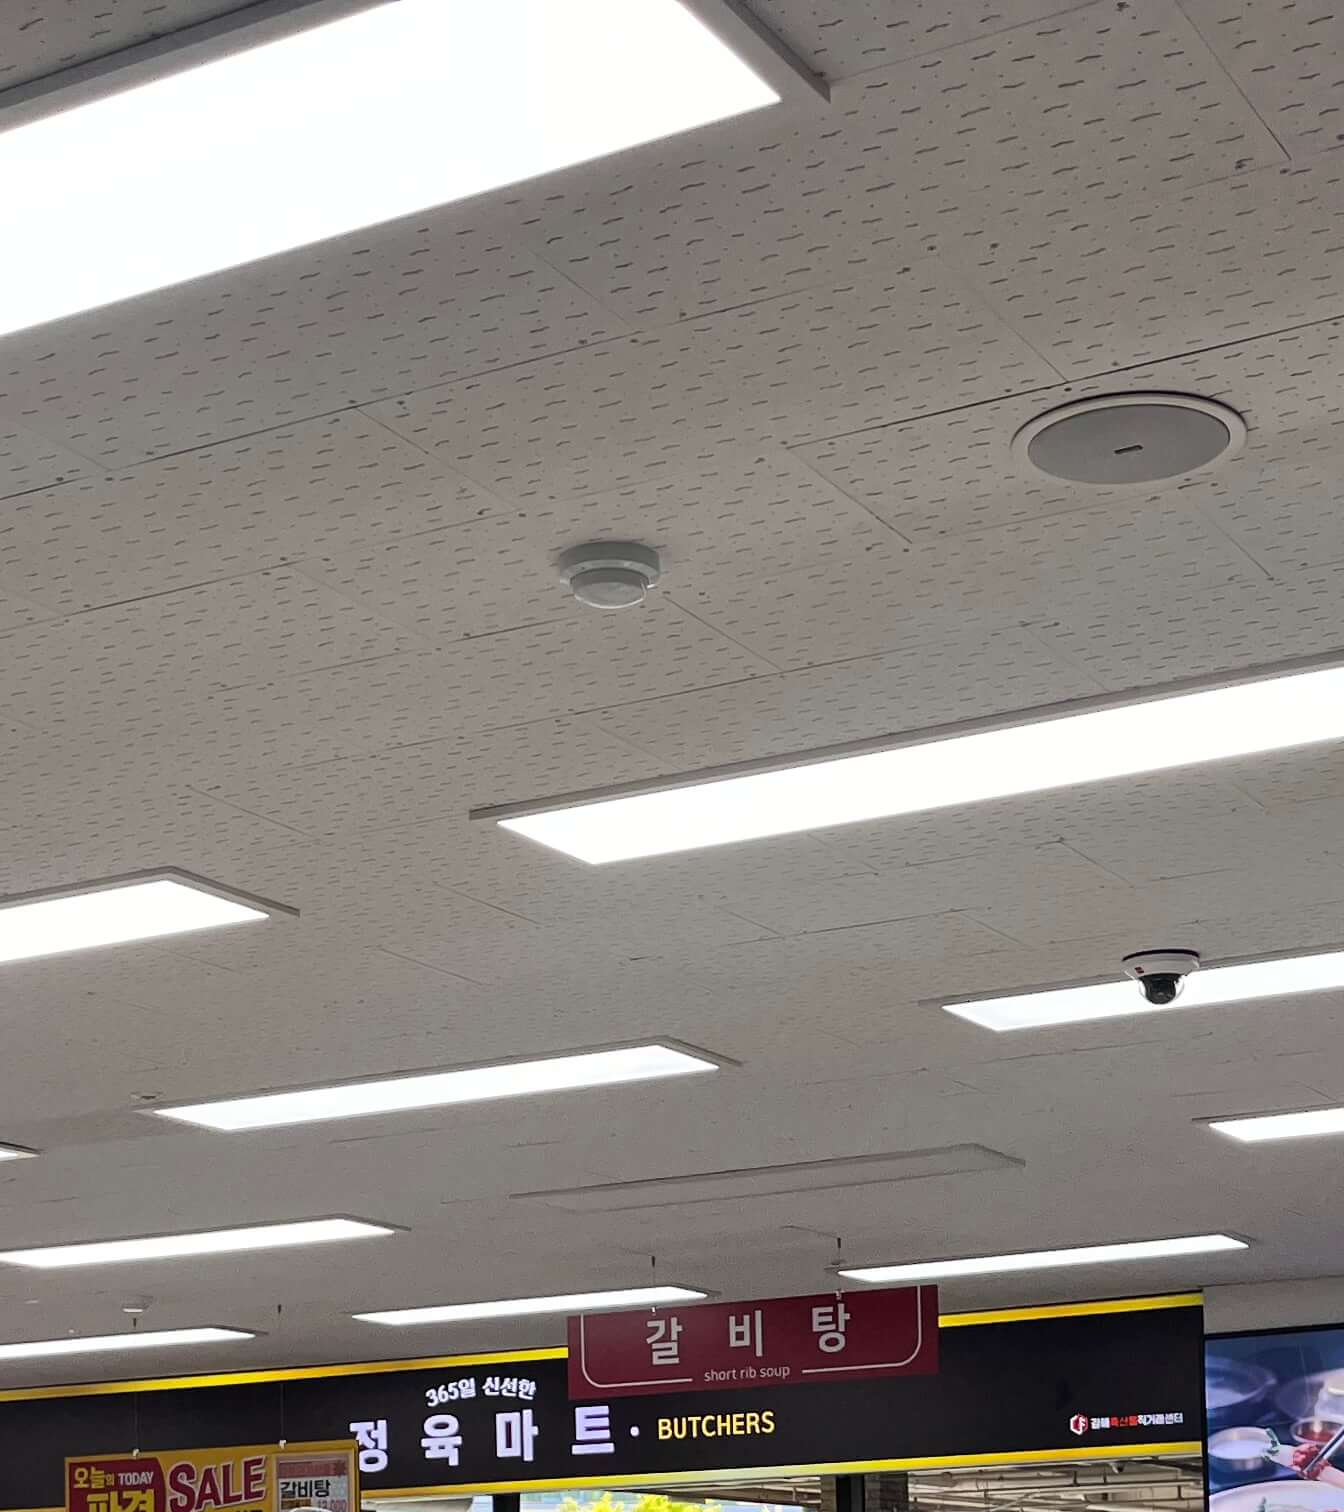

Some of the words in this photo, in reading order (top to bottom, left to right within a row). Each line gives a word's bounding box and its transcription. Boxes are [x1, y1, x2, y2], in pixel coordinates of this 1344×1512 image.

[704, 1367, 737, 1382] short
[740, 1366, 756, 1380] rib
[759, 1365, 790, 1380] soup
[425, 1377, 476, 1408] 365일
[482, 1376, 536, 1400] 신선한
[657, 1411, 776, 1441] BUTCHERS
[74, 1467, 114, 1488] 오늘의
[117, 1471, 154, 1485] TODAY
[280, 1478, 331, 1498] 갈비탕
